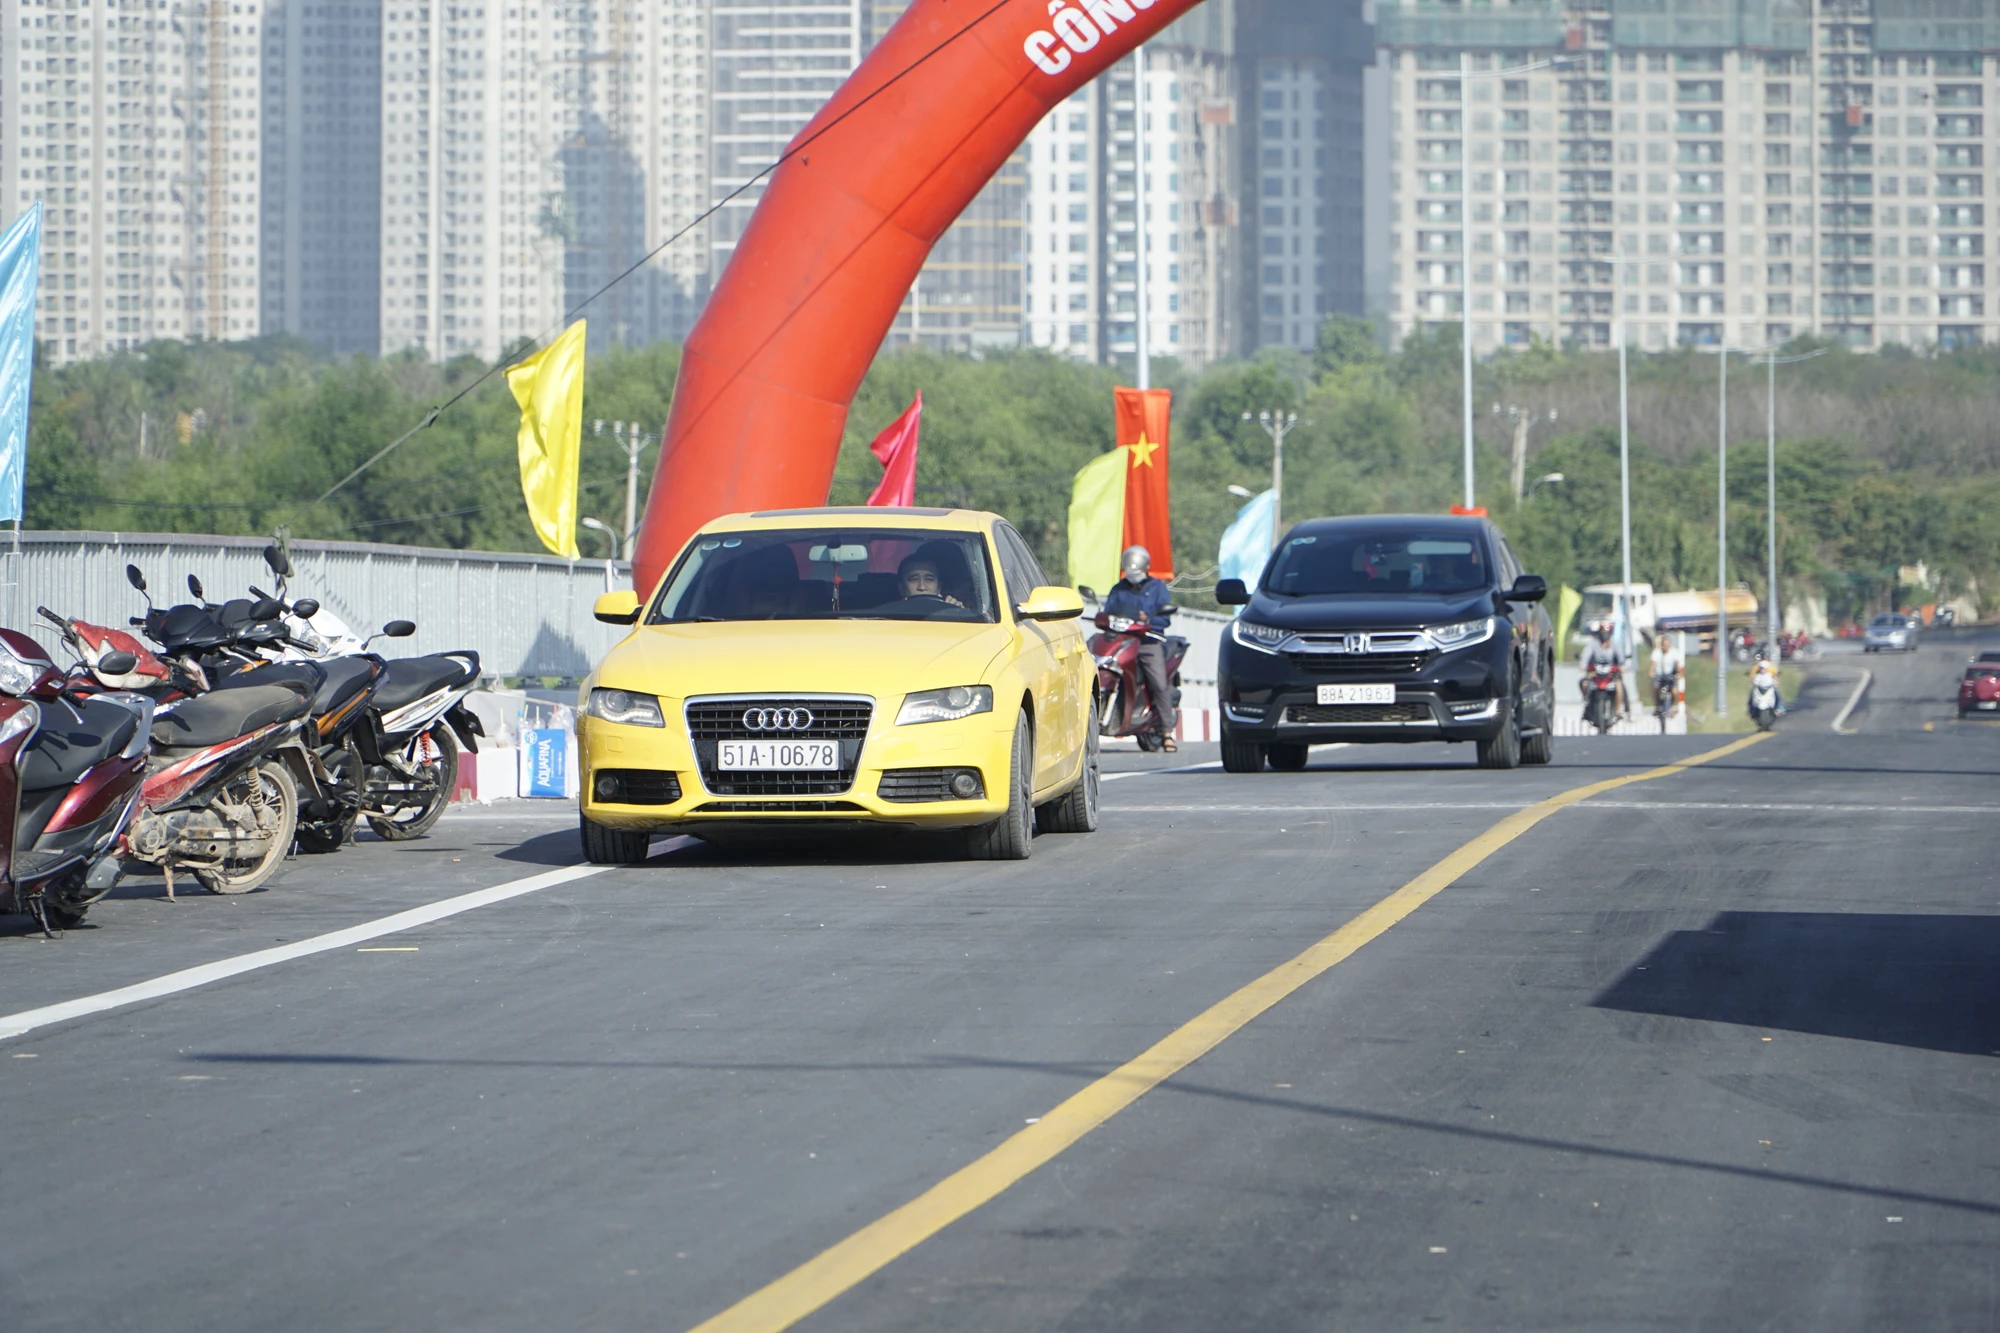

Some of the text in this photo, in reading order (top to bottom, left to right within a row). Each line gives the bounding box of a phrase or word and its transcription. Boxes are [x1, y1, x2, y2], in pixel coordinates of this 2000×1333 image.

[1023, 0, 1156, 75] CÔN
[536, 737, 552, 788] AQUAFINA
[723, 744, 834, 767] 51A-106.78
